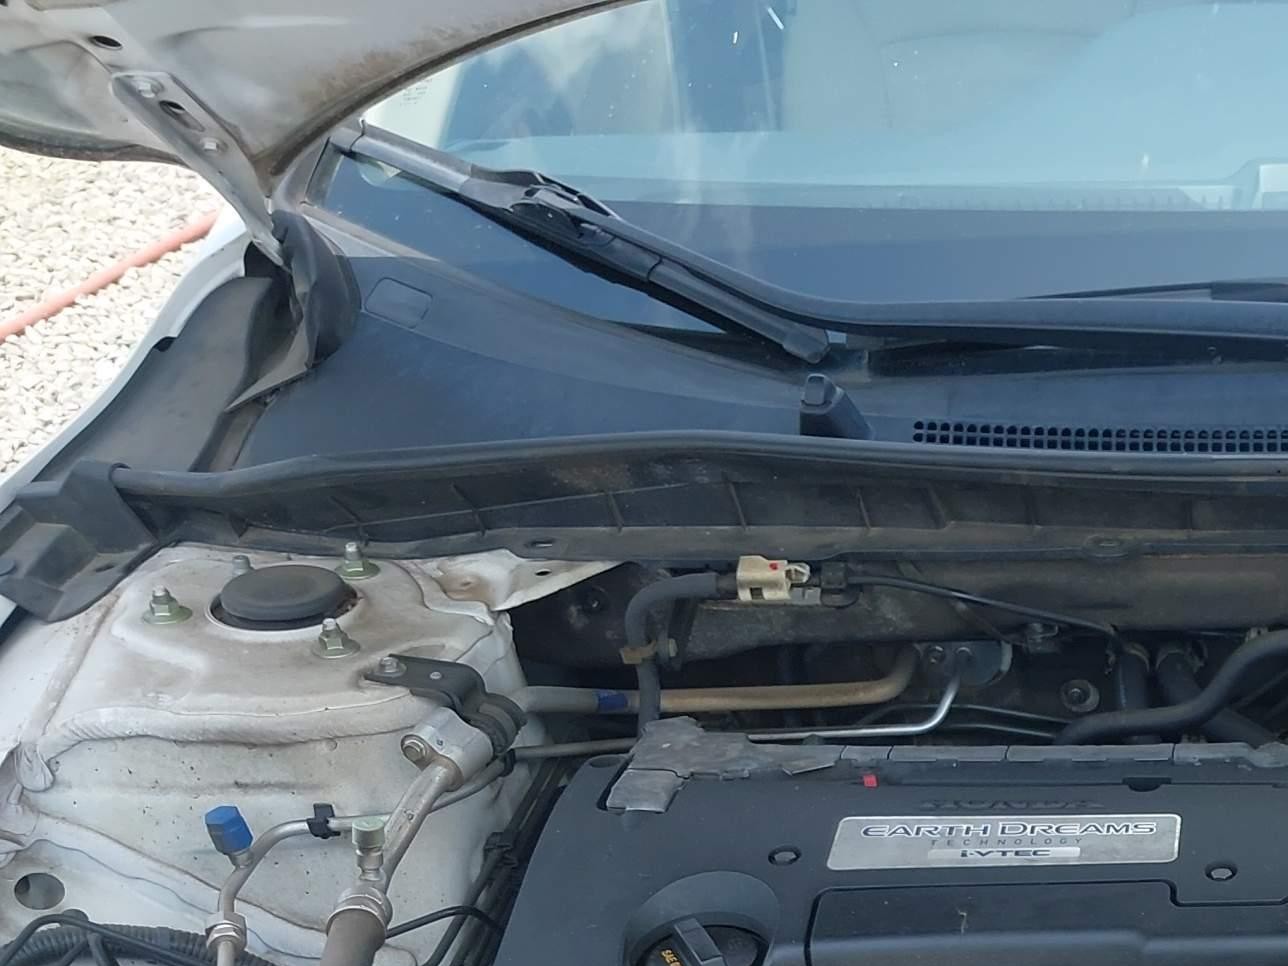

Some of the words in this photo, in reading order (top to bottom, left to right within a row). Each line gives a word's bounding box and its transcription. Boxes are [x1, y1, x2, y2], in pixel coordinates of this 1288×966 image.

[862, 823, 992, 837] EARTH
[998, 821, 1157, 836] DREAMS
[930, 838, 1084, 847] TECHNOLOGY
